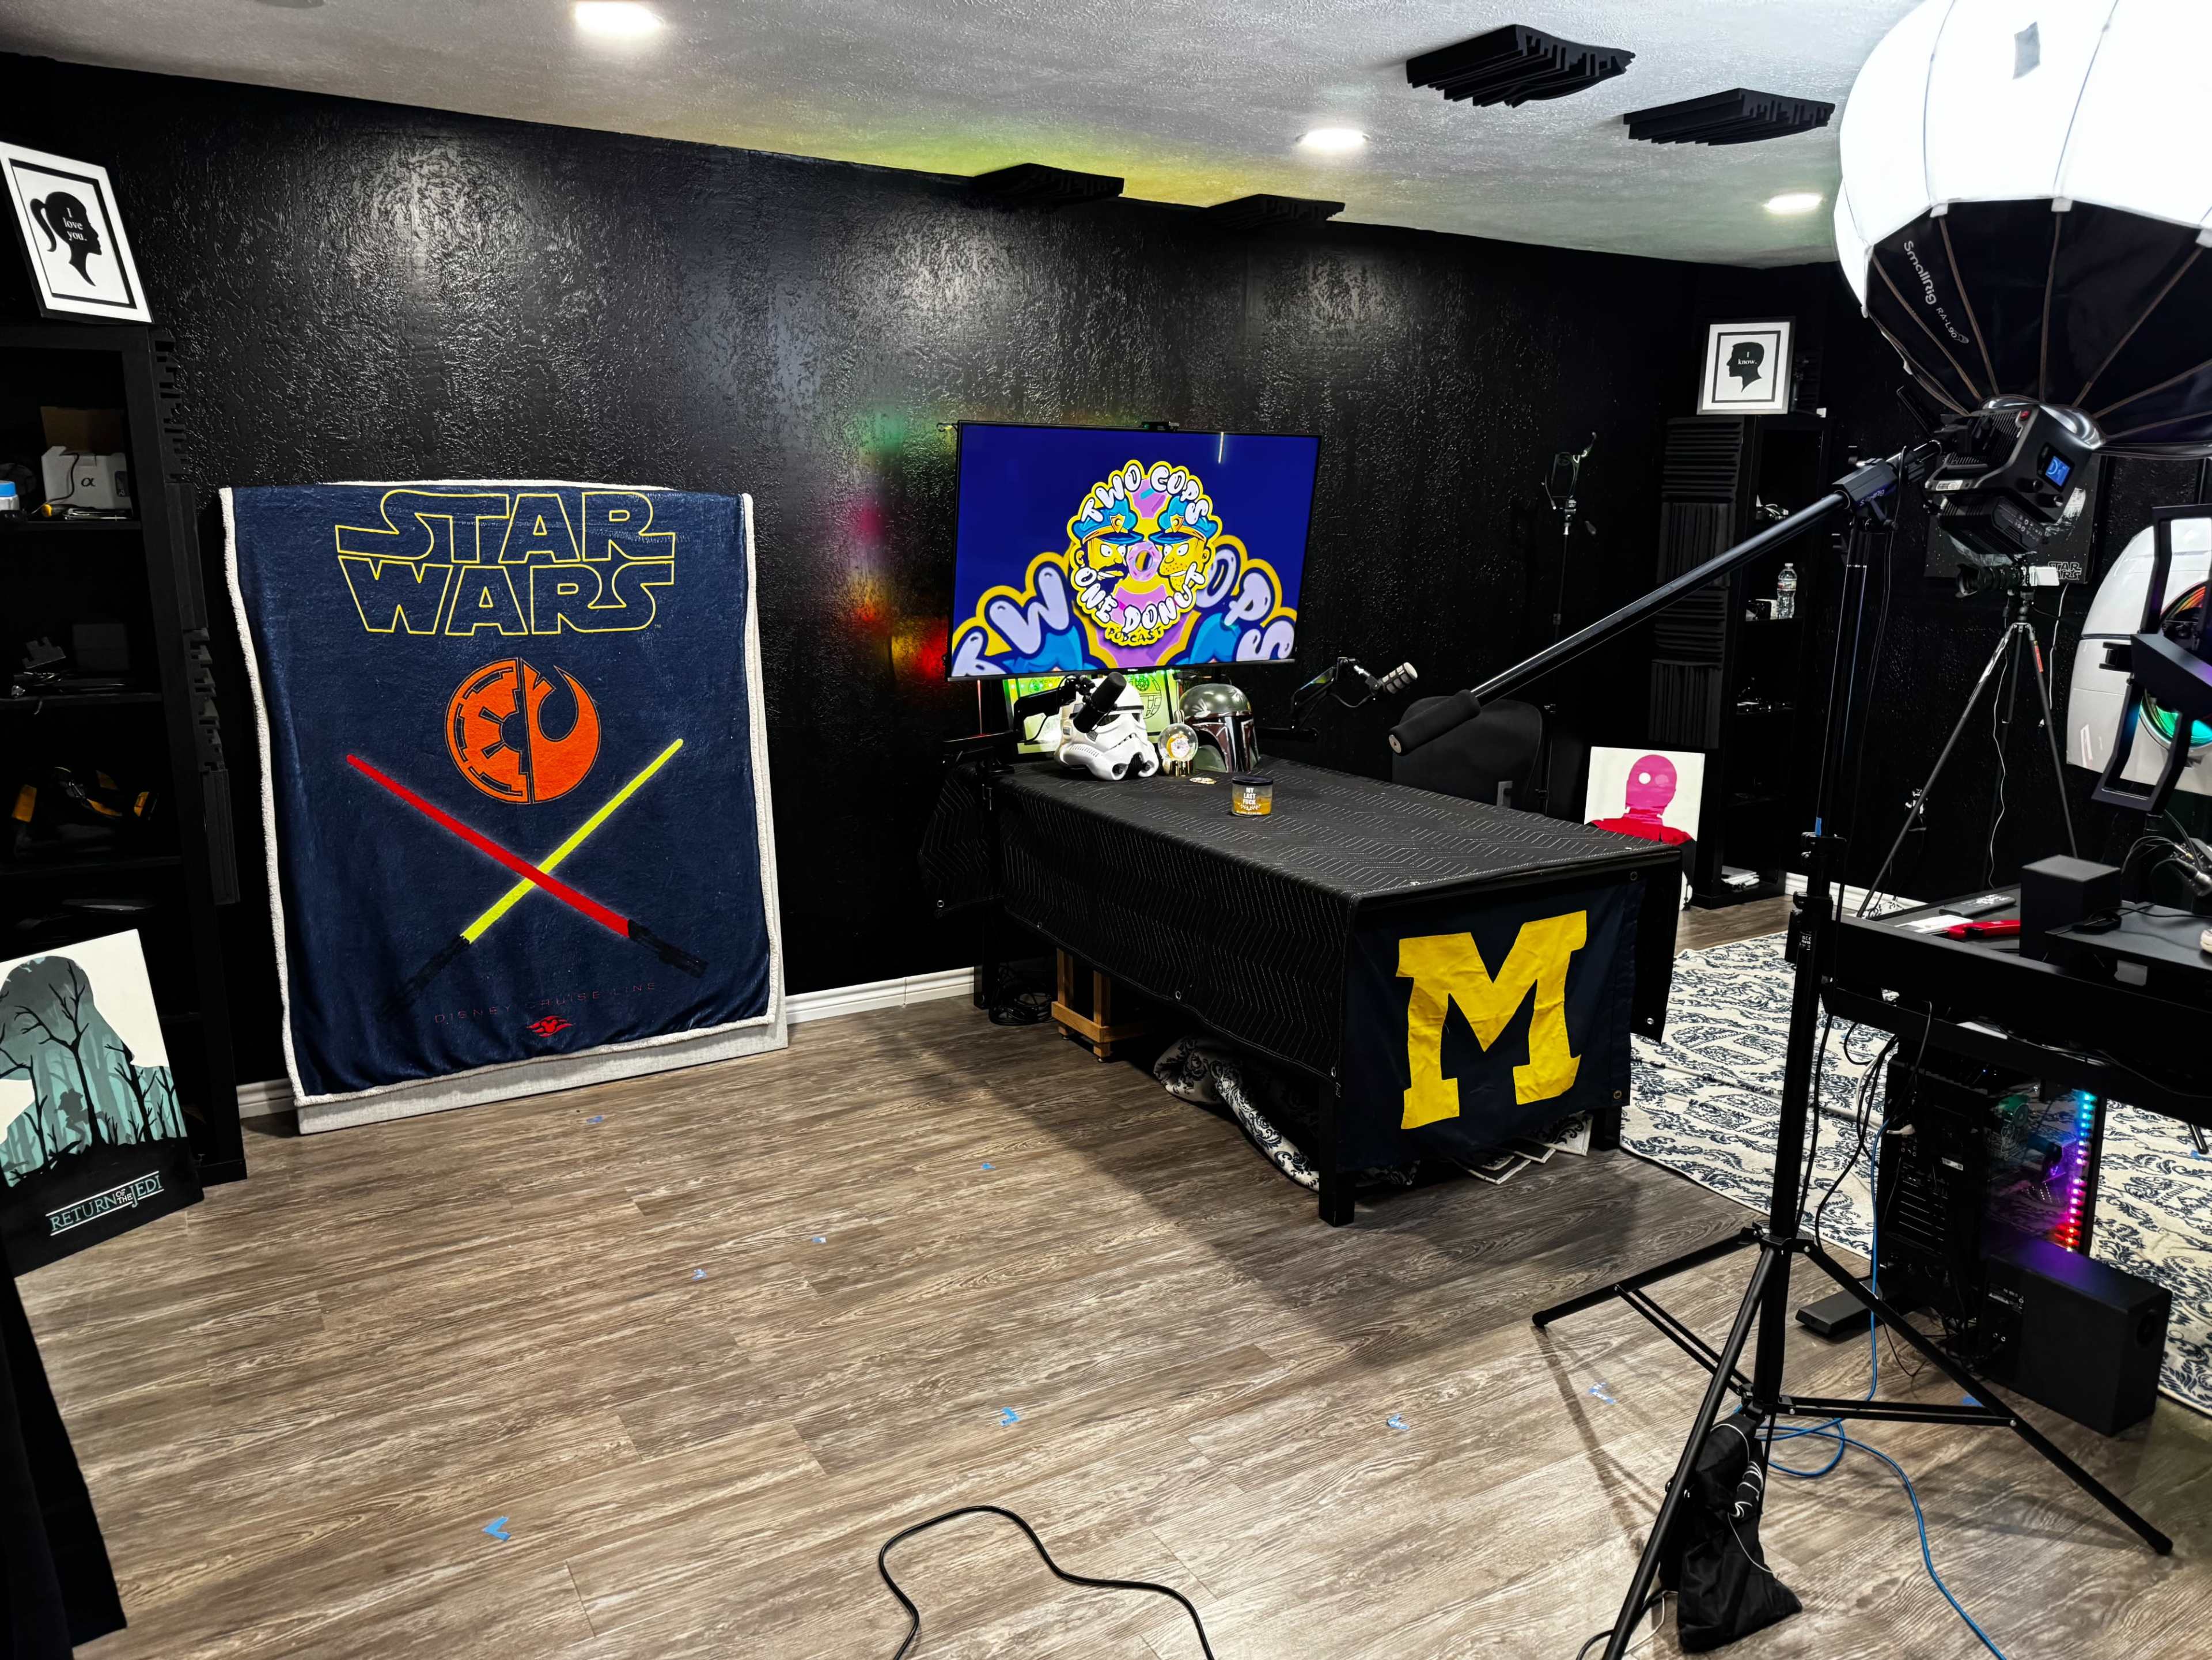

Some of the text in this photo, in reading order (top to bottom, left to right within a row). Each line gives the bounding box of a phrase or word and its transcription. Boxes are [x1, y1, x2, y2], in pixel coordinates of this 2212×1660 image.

[63, 217, 84, 230] love
[67, 207, 73, 218] I
[66, 230, 88, 241] you.
[1903, 240, 1937, 305] SmallRig
[1081, 464, 1209, 525] TWO COPS
[335, 489, 676, 564] STAR
[338, 555, 675, 635] WARS
[1075, 562, 1206, 632] ONE DONUT
[1194, 549, 1294, 661] OPS
[1107, 625, 1162, 642] PODCAST
[1395, 909, 1587, 1130] M
[116, 1189, 126, 1198] OF
[117, 1194, 132, 1204] THE
[131, 1175, 162, 1208] JEDI
[50, 1195, 116, 1232] RETURN
